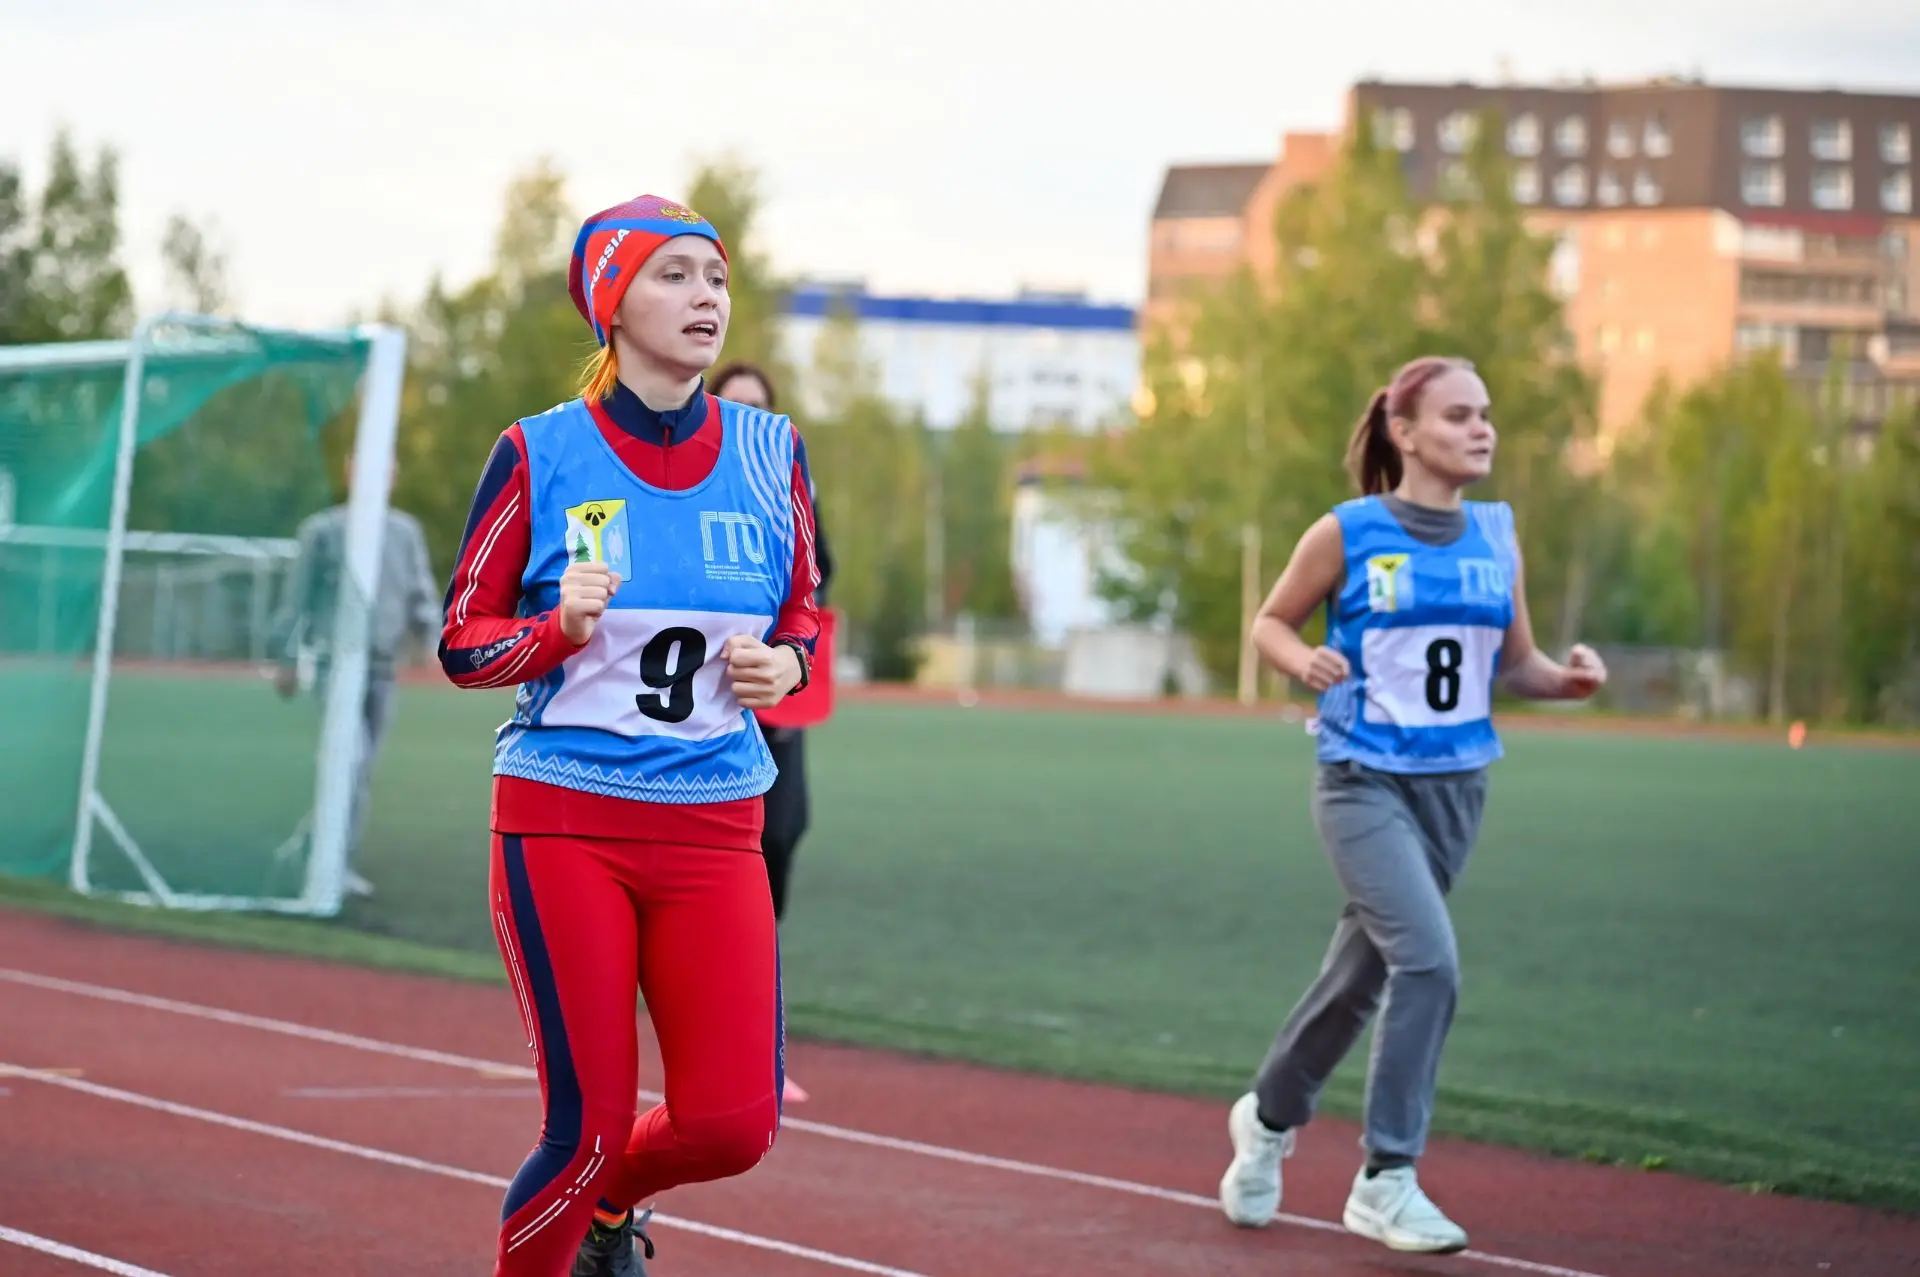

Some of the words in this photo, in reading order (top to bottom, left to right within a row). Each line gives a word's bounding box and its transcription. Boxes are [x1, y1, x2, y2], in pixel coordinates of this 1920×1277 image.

[700, 511, 767, 564] ГТО
[635, 626, 707, 723] 9
[1425, 637, 1463, 713] 8
